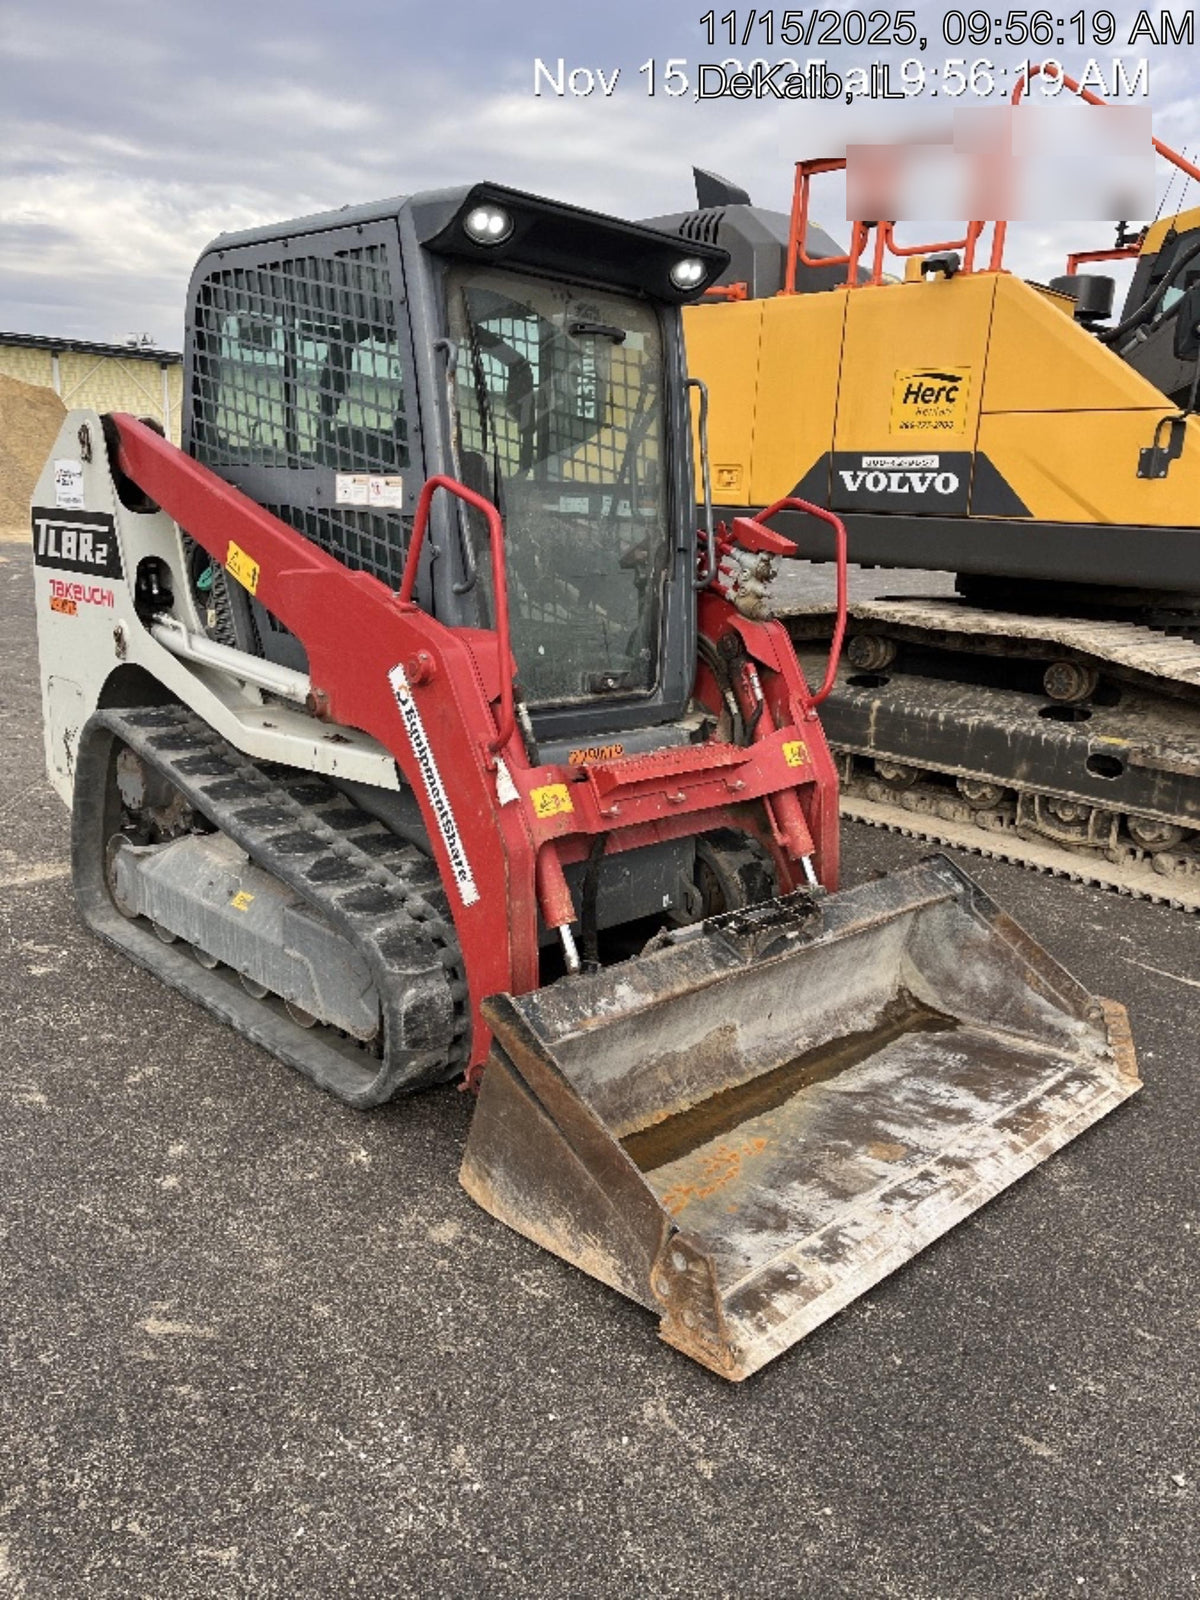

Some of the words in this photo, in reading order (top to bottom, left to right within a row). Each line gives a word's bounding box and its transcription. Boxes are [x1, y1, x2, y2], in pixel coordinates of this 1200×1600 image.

[902, 381, 959, 404] Herc
[838, 470, 960, 494] VOLVO
[404, 705, 468, 884] EquipmentShare
